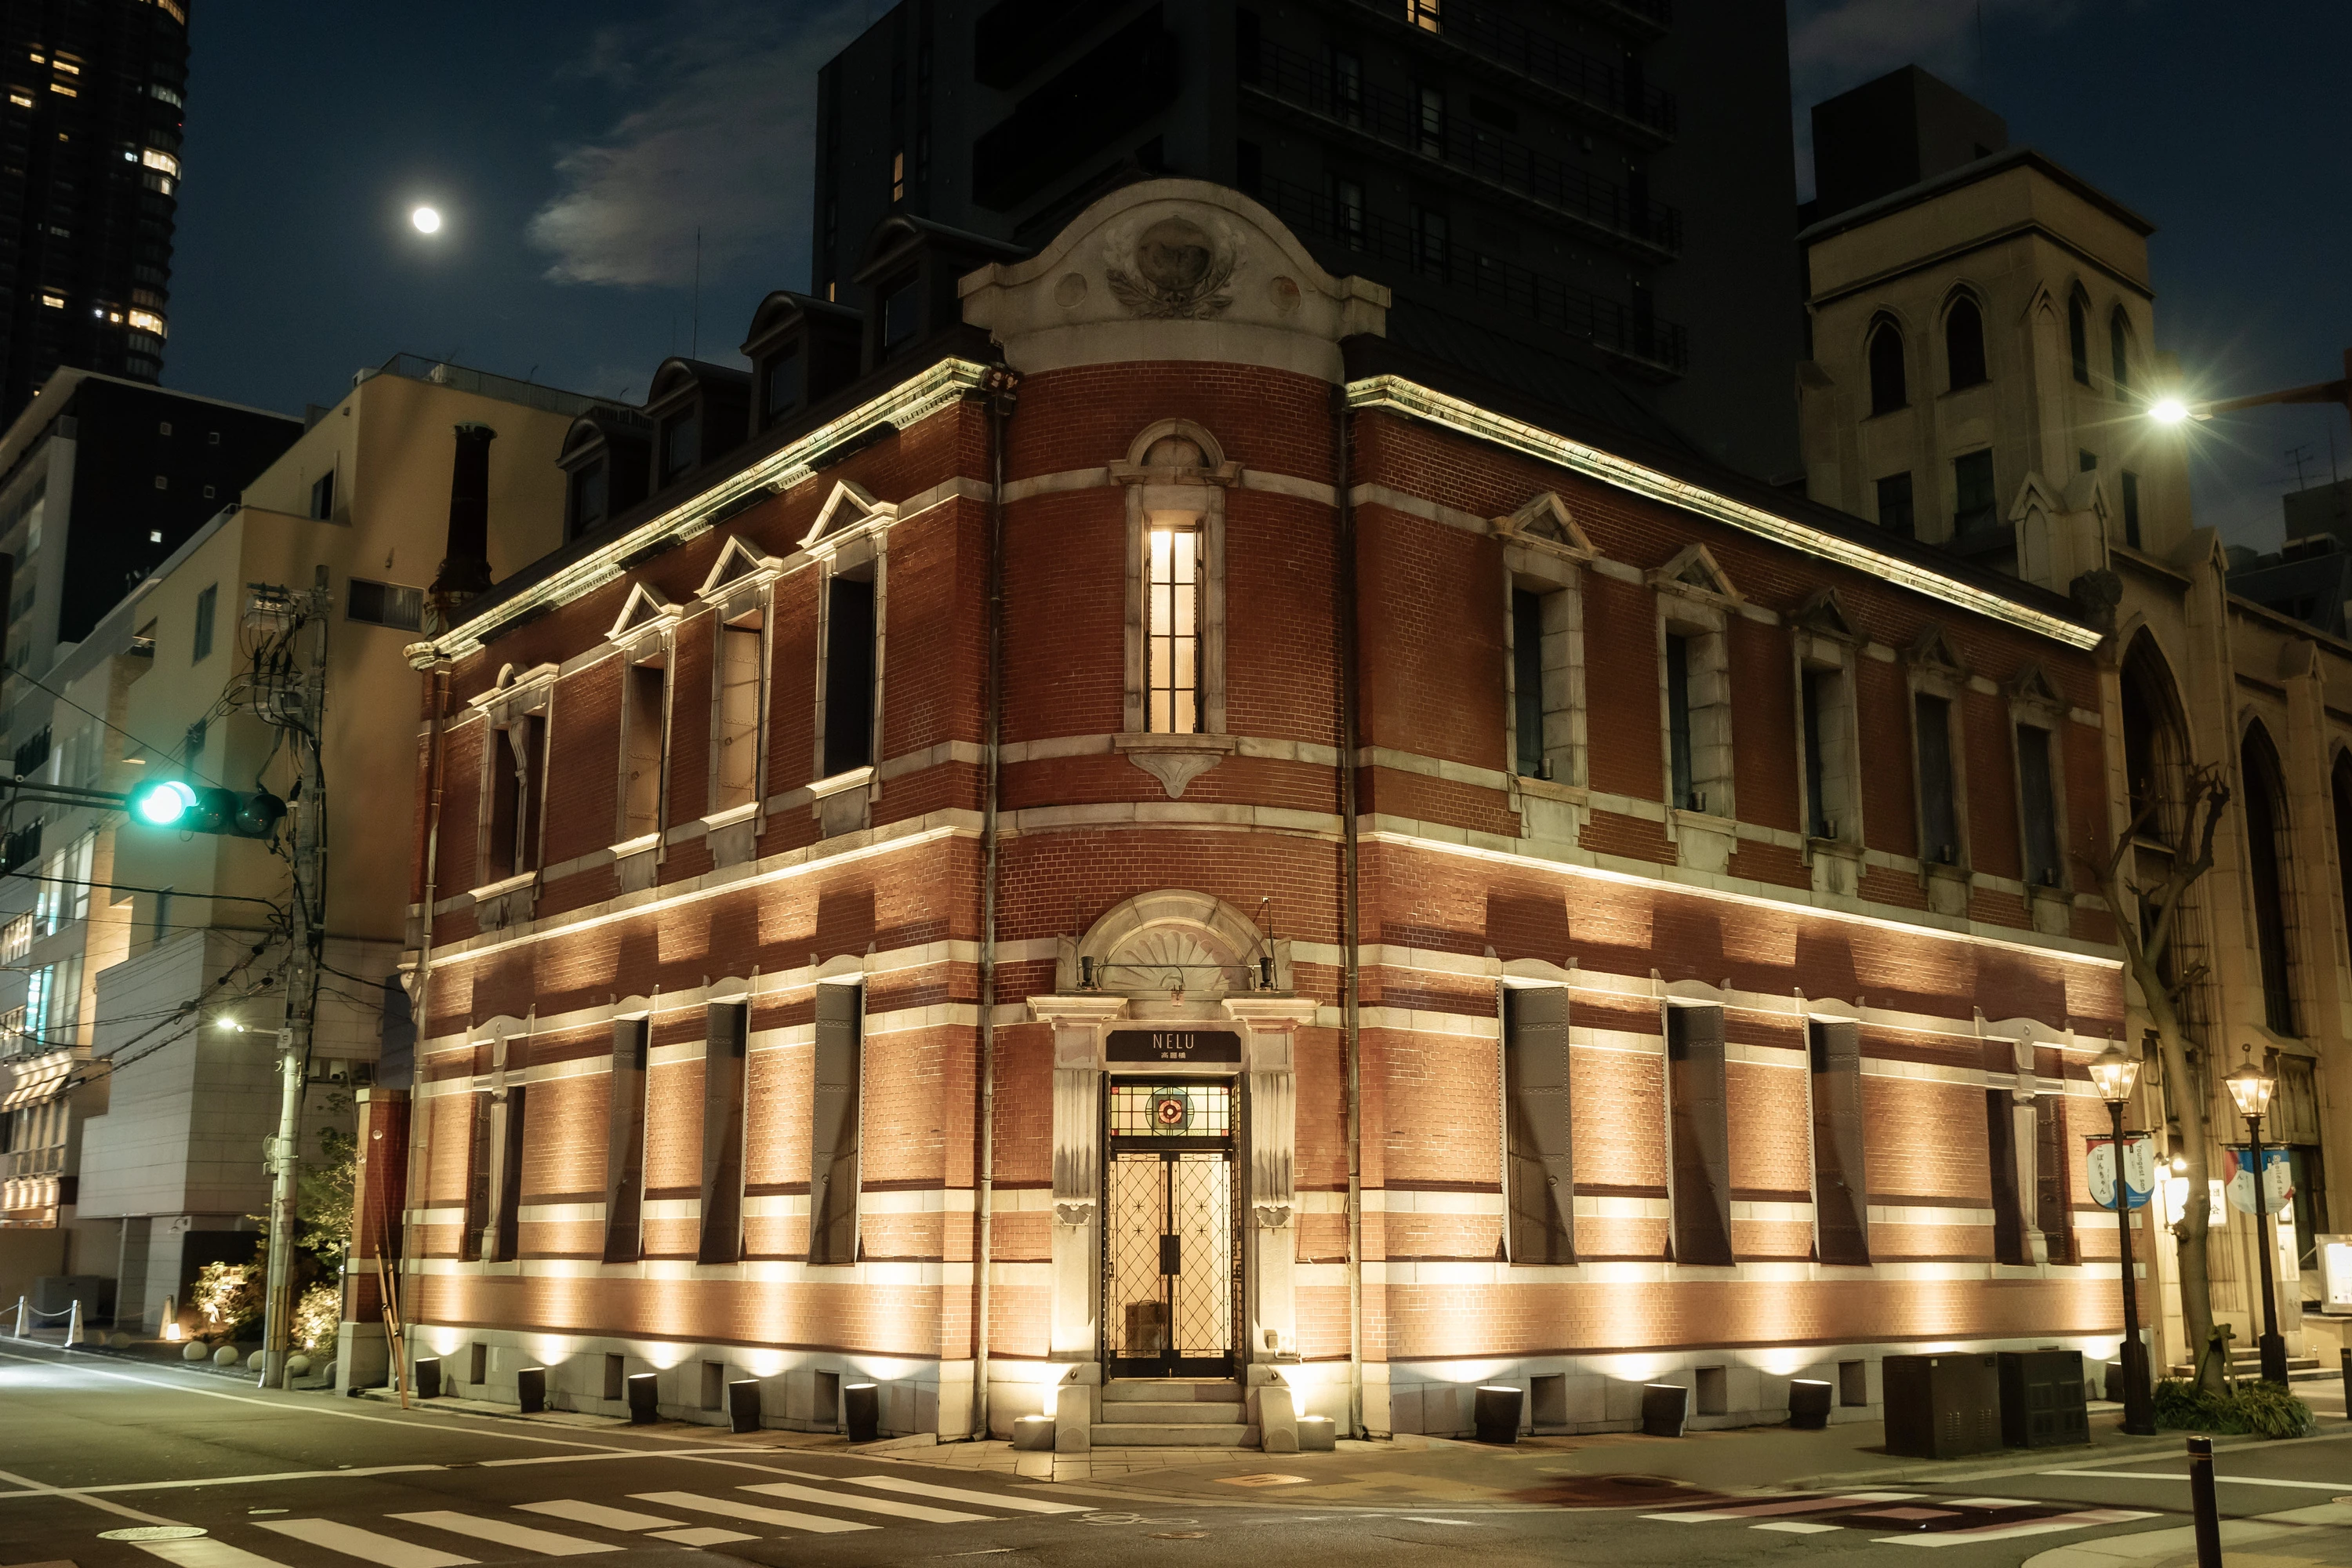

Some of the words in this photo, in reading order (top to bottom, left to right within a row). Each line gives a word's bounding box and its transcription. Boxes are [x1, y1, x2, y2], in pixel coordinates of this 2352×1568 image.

[1153, 1033, 1194, 1049] NELU
[2136, 1145, 2145, 1176] Youngest
[2274, 1156, 2283, 1184] Spoiled
